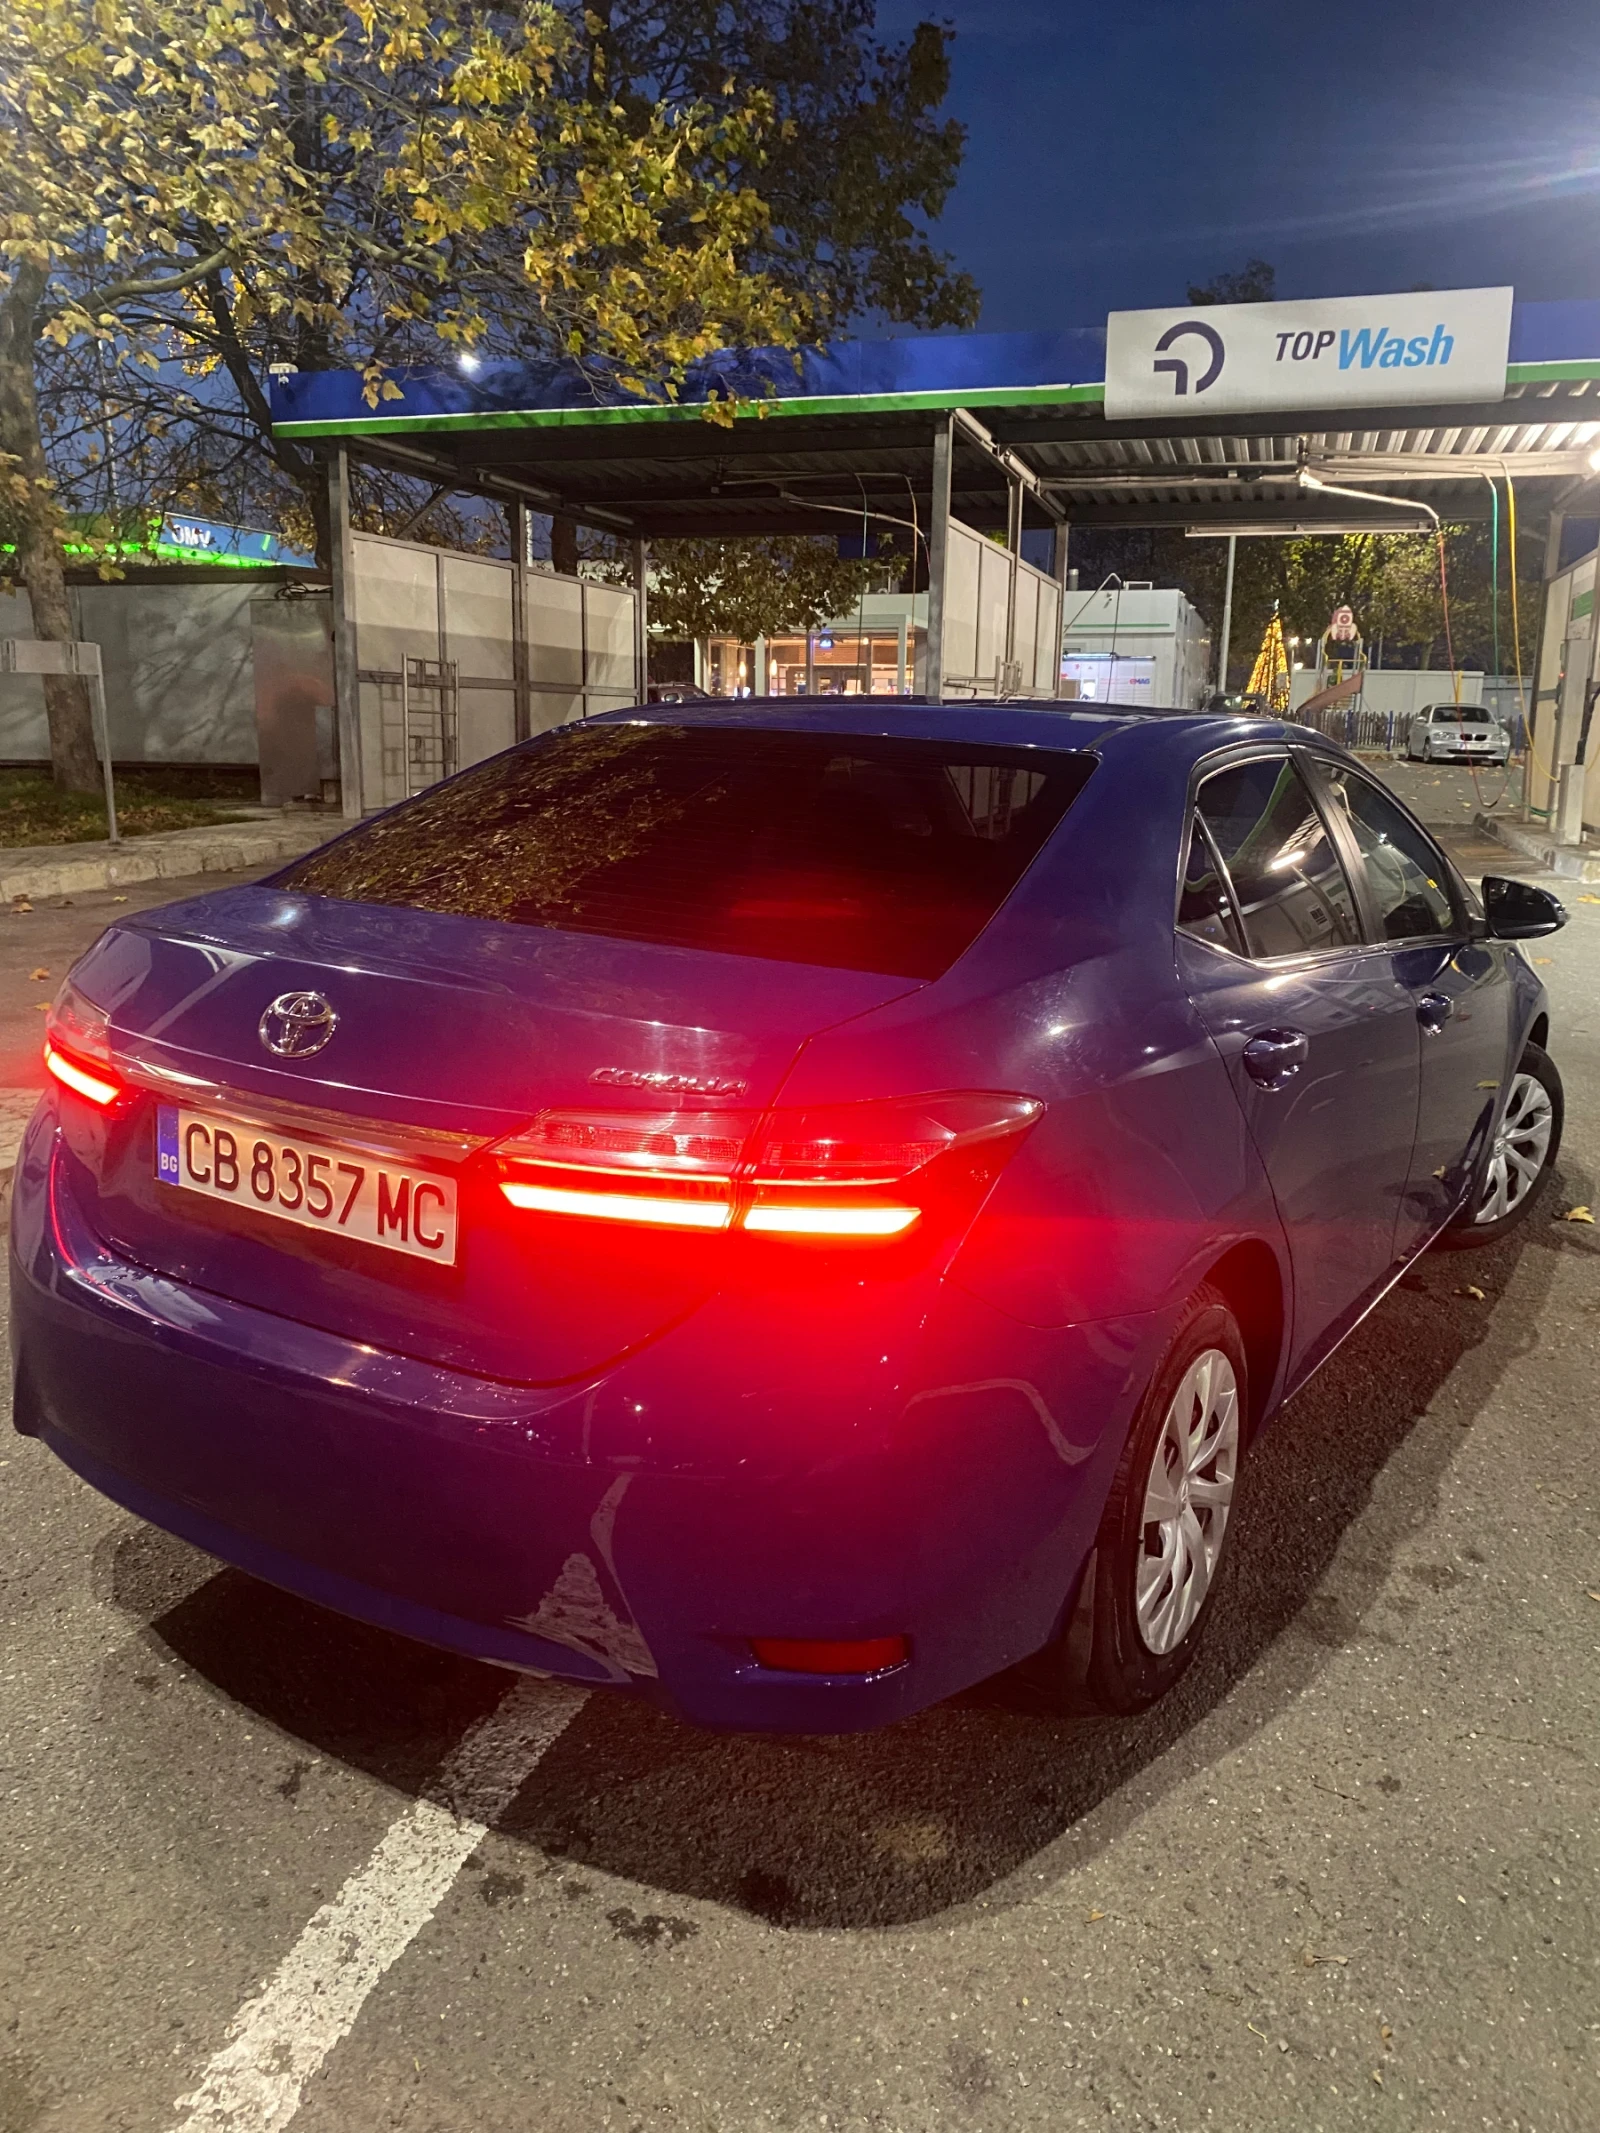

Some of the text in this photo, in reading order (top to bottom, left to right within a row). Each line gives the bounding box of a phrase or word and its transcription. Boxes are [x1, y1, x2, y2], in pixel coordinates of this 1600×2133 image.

[160, 1152, 178, 1173] BG
[186, 1122, 446, 1250] CB 8357 MC
